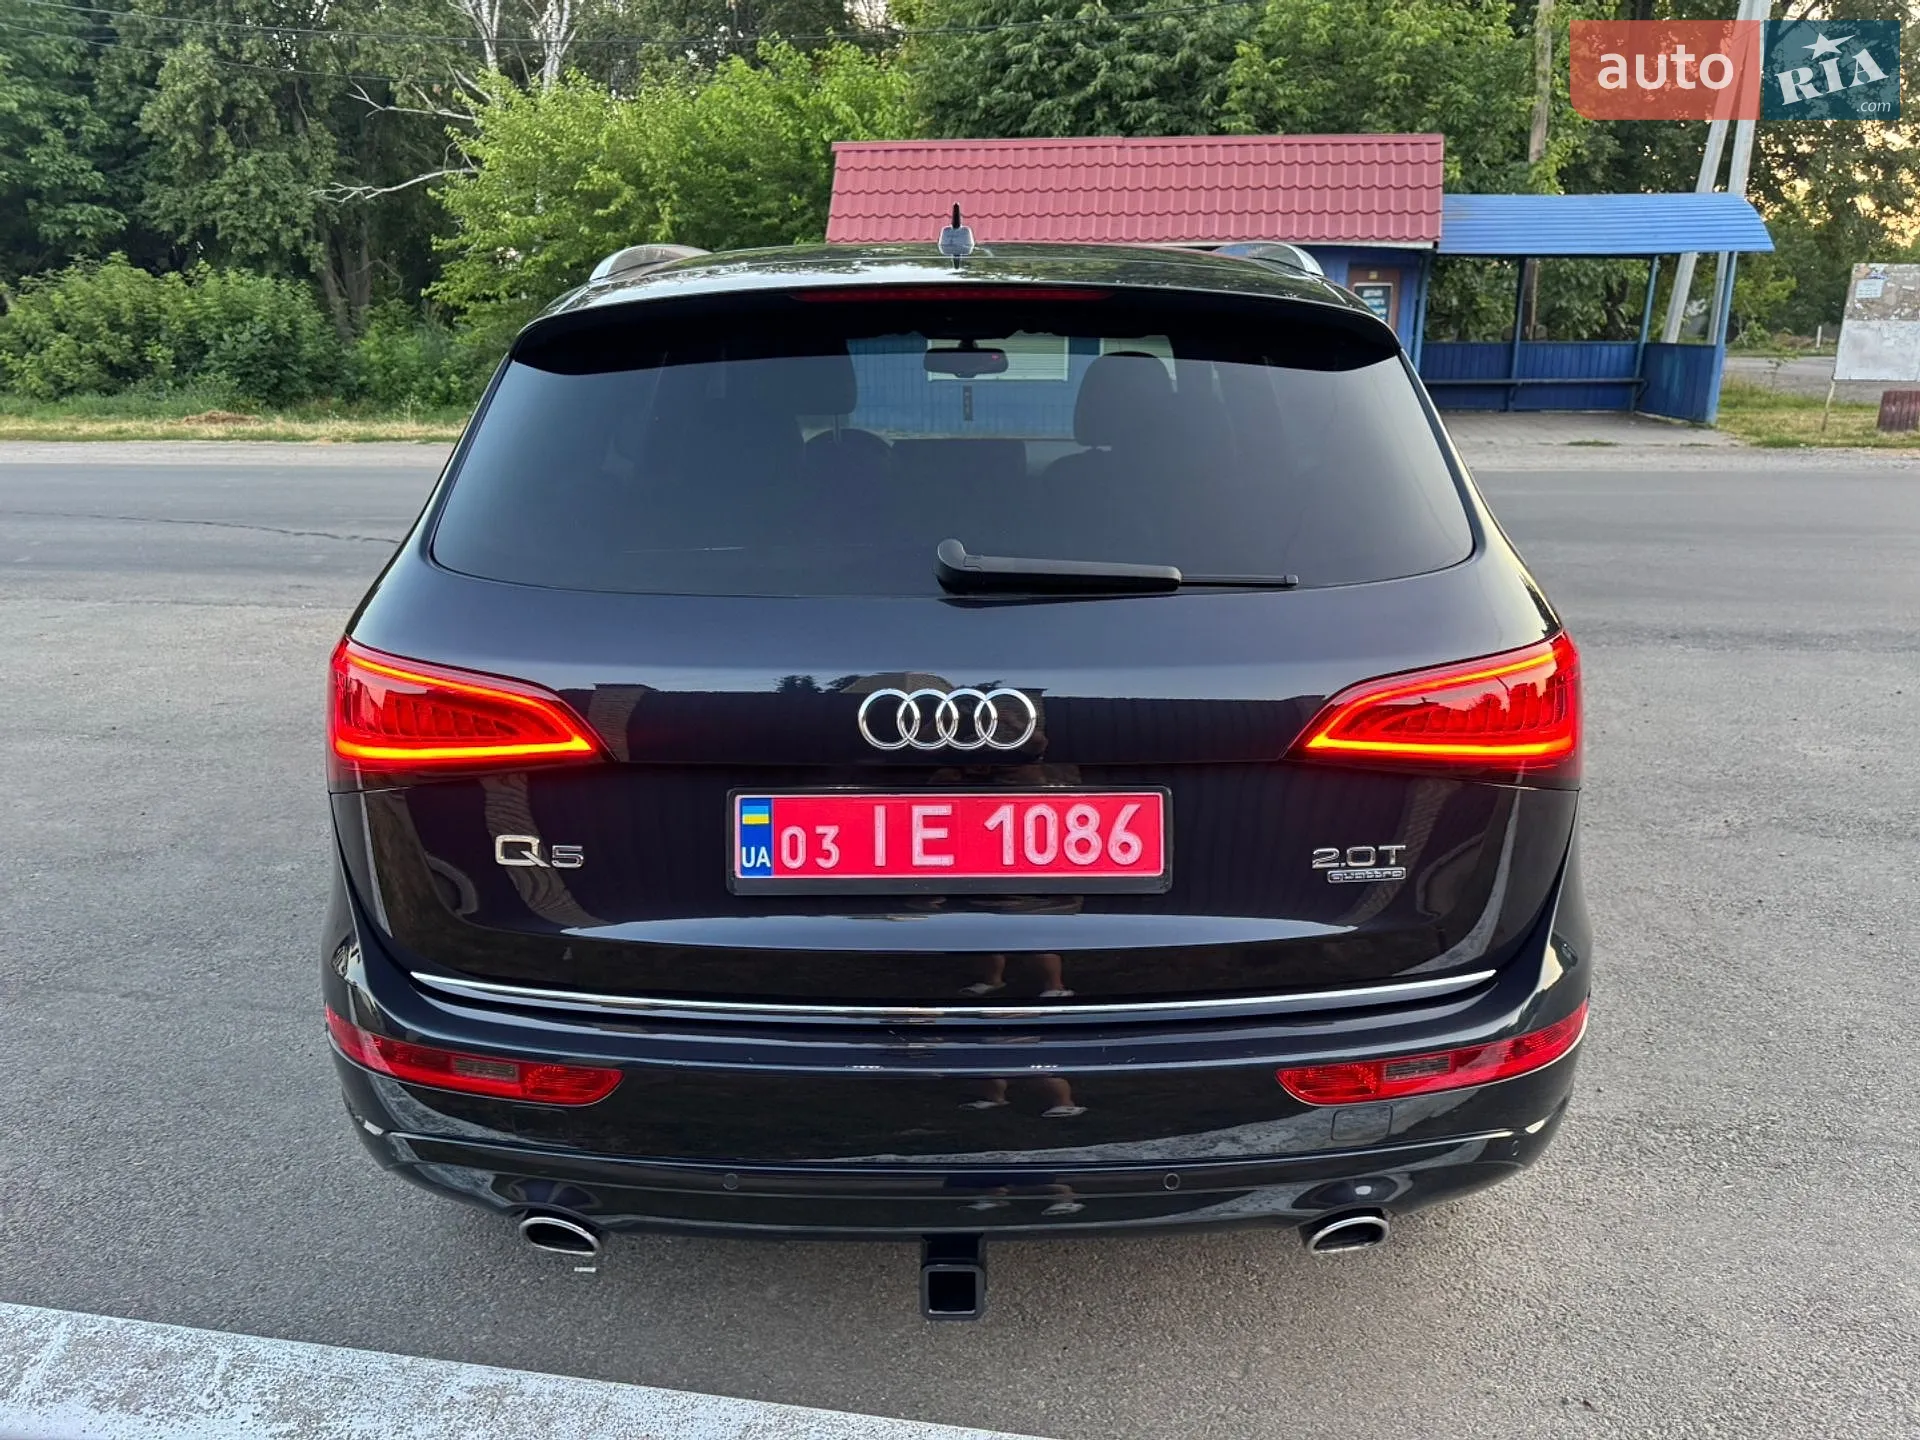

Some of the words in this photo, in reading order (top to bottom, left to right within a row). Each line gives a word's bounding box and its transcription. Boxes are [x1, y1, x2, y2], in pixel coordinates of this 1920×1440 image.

[780, 824, 840, 869] 03
[983, 803, 1143, 866] 1086
[495, 834, 584, 868] Q5
[741, 845, 771, 868] UA
[1311, 845, 1406, 869] 2.0T
[1329, 868, 1405, 883] quattro
